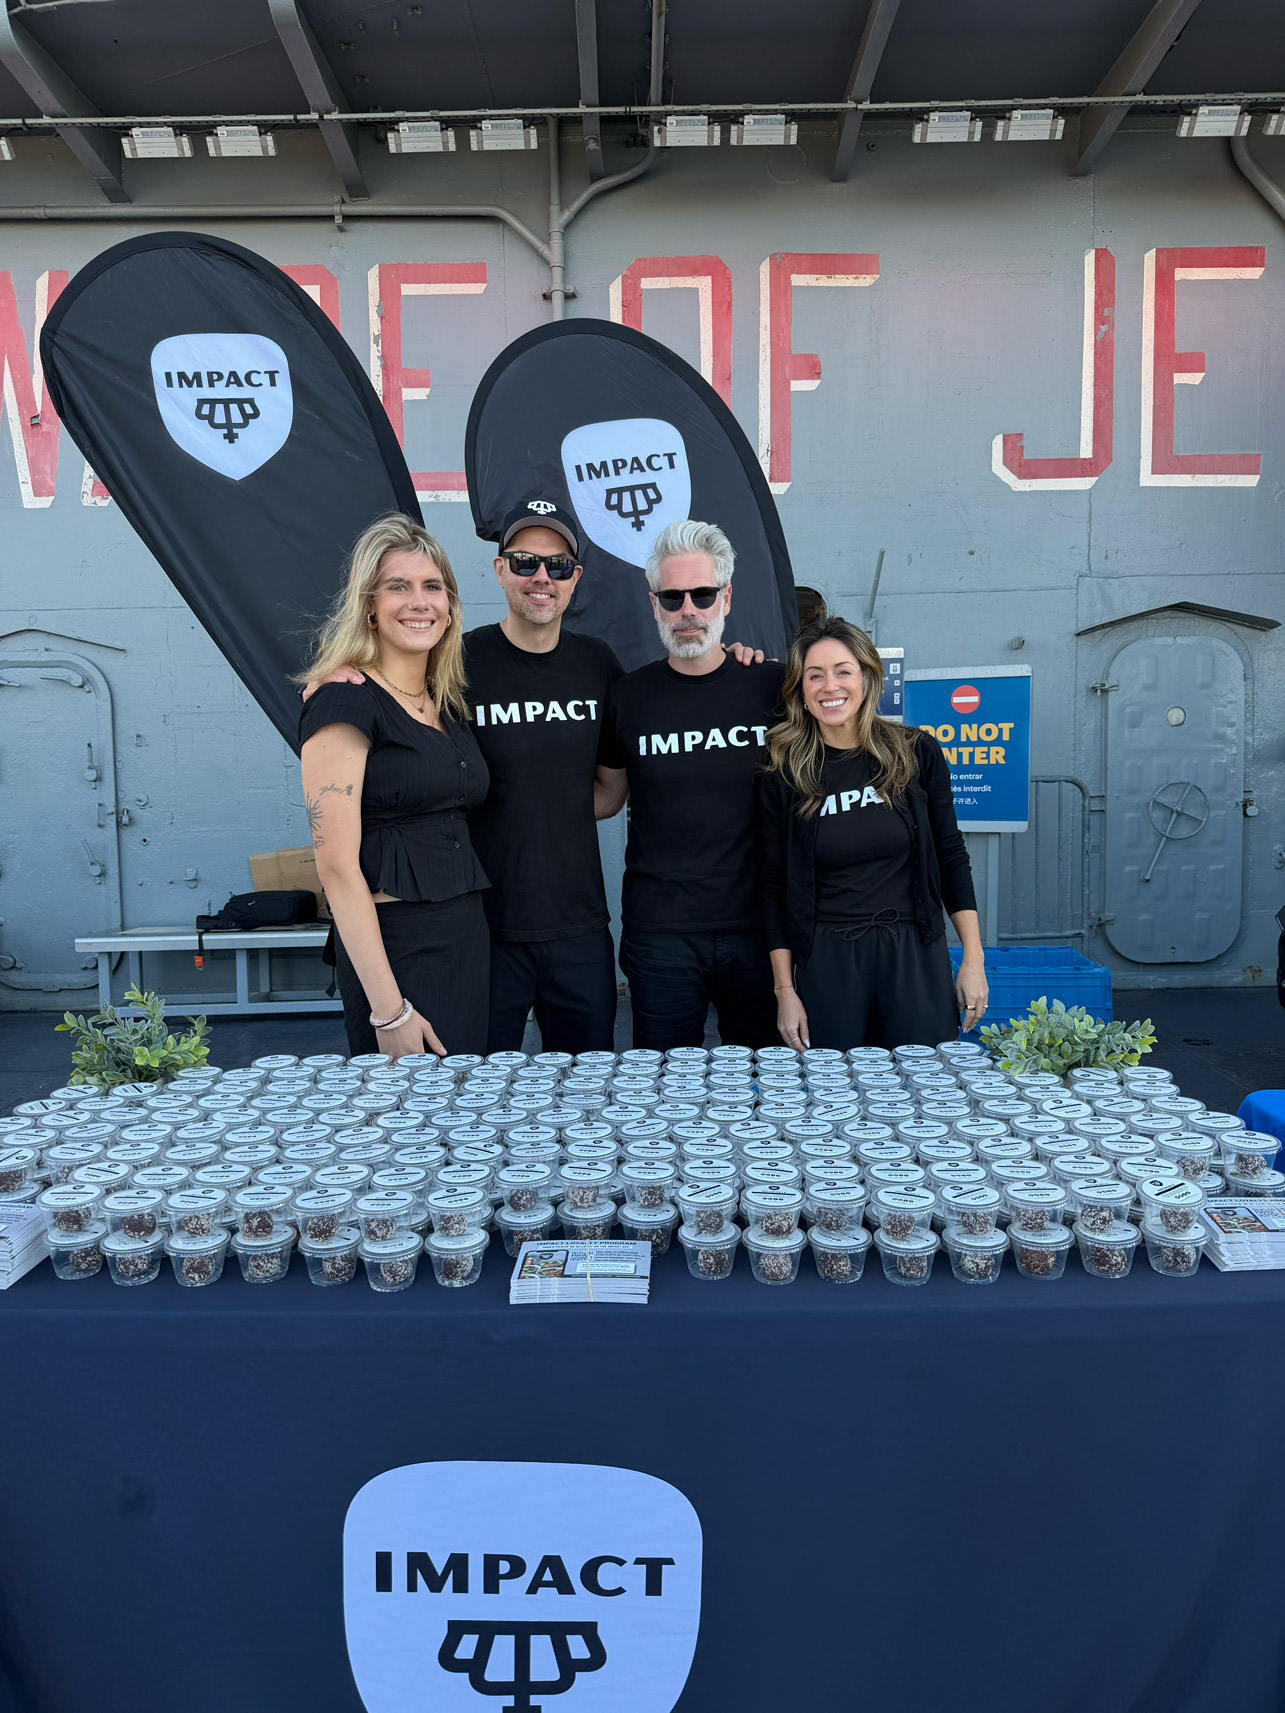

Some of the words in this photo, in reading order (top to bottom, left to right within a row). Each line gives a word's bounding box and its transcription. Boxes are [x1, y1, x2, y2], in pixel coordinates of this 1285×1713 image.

[164, 370, 280, 388] IMPACT
[992, 246, 1265, 491] JE
[574, 452, 677, 482] IMPACT
[476, 700, 598, 727] IMPACT
[638, 725, 768, 756] IMPACT
[960, 723, 1014, 742] NOT
[941, 746, 1006, 765] NTER
[820, 785, 885, 817] MPA
[963, 784, 992, 792] interdit
[375, 1551, 676, 1597] IMPACT
